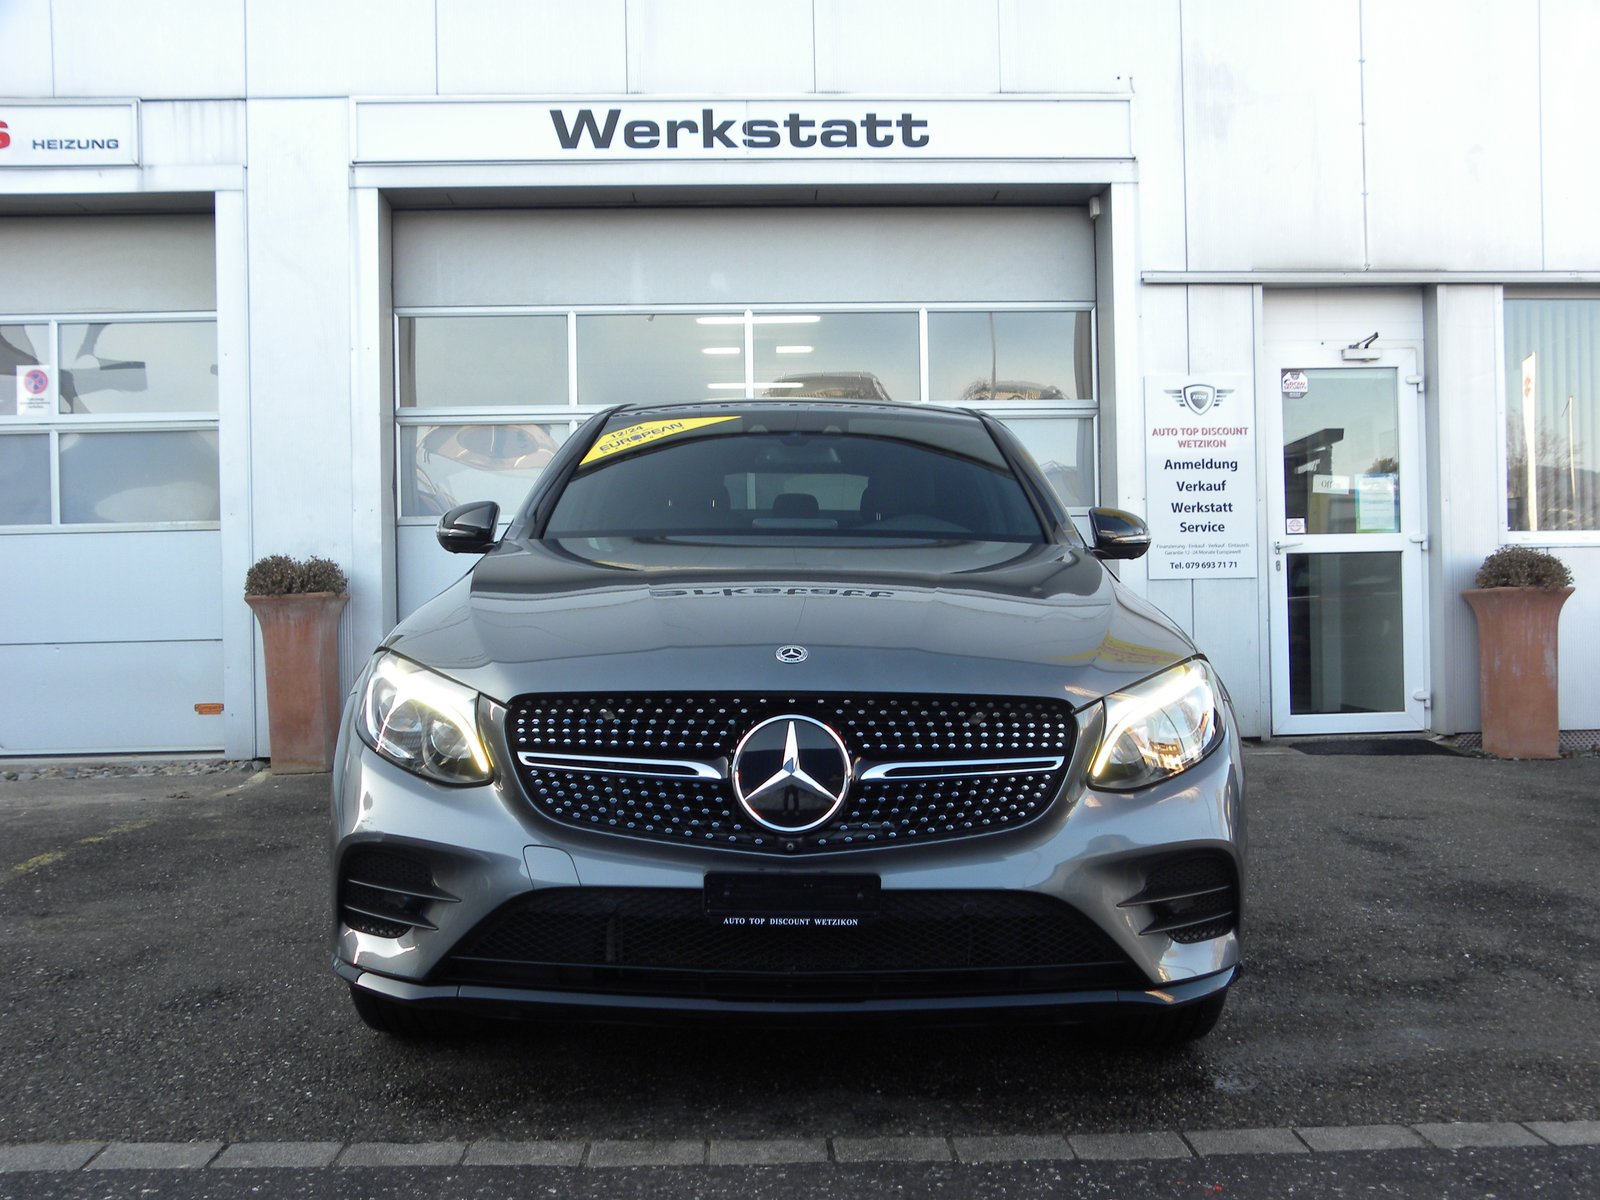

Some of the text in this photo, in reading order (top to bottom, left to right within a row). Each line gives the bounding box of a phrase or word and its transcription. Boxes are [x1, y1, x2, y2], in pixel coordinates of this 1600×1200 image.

[549, 108, 930, 149] Werkstatt
[32, 139, 119, 150] HEIZUNG
[611, 425, 643, 439] 12/24
[1152, 427, 1248, 436] AUTO TOP DISCOUNT
[1177, 439, 1227, 448] WETZIKON
[1164, 458, 1238, 472] Anmeldung
[1176, 480, 1227, 491] Verkauf
[1171, 501, 1233, 513] Werkstatt
[1180, 521, 1225, 533] Service
[1201, 561, 1216, 569] 693
[723, 917, 859, 926] AUTO TOP DISCOUNT WETZIKON
